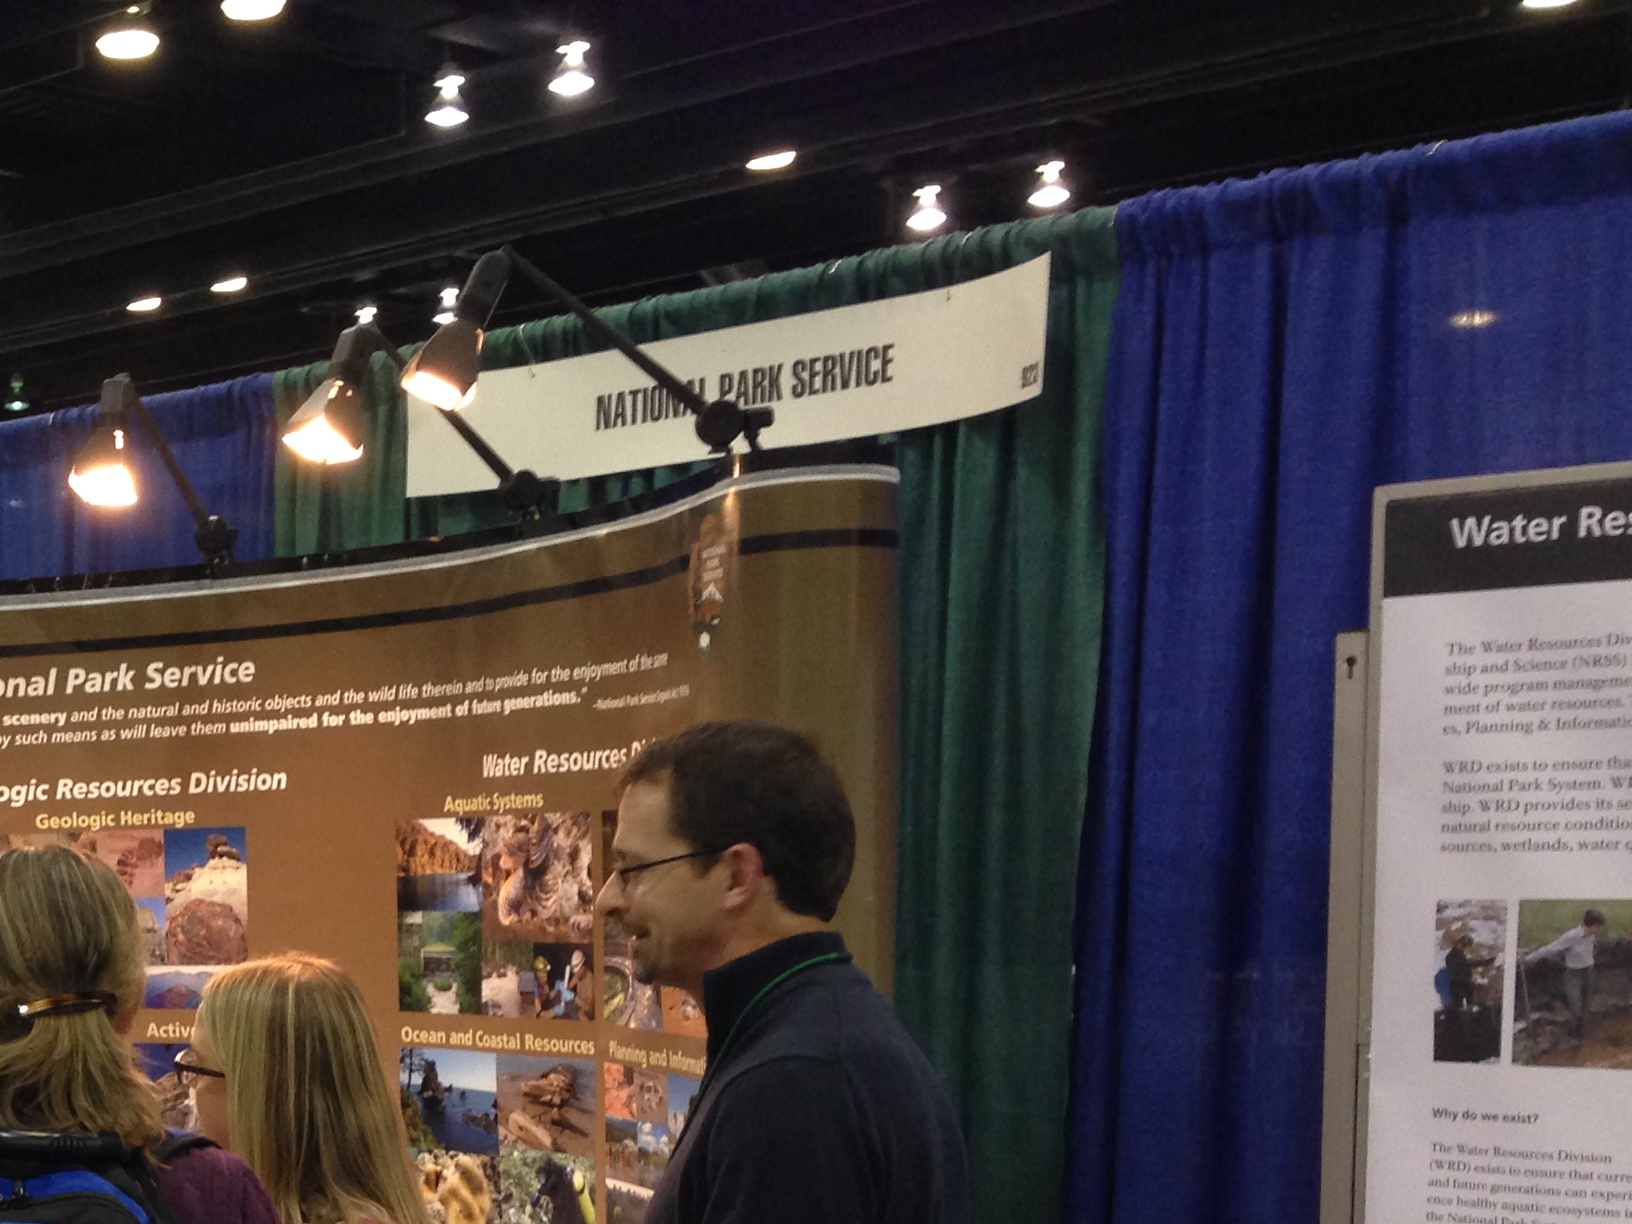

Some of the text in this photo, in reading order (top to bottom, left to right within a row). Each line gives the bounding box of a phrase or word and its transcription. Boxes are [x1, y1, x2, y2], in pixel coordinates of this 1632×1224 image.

[719, 361, 784, 406] PARK
[790, 343, 895, 399] SERVICE
[1449, 514, 1567, 549] Water
[1446, 636, 1603, 657] The Water Resources
[66, 662, 135, 694] Park
[144, 656, 256, 690] Service
[1445, 660, 1476, 677] ship
[1481, 660, 1509, 674] and
[1513, 658, 1568, 673] Science
[2, 708, 67, 728] scenery
[70, 706, 97, 723] and
[101, 705, 124, 720] the
[128, 701, 179, 718] natural
[182, 700, 209, 716] and
[212, 697, 262, 714] historic
[265, 694, 312, 713] objects
[315, 689, 340, 706] and
[343, 688, 365, 704] the
[368, 684, 396, 702] wild
[399, 684, 418, 700] life
[422, 681, 462, 698] therein
[465, 676, 484, 693] and
[485, 677, 494, 692] to
[495, 671, 528, 693] provide
[531, 667, 548, 685] for
[551, 664, 570, 682] the
[573, 658, 627, 682] enjoyment
[629, 653, 640, 672] of
[1444, 679, 1548, 697] wide program
[1443, 700, 1546, 715] ment of water
[15, 729, 48, 746] such
[51, 730, 98, 744] means
[101, 728, 116, 742] as
[120, 724, 146, 741] will
[150, 722, 187, 739] leave
[190, 720, 226, 736] them
[230, 712, 318, 735] unimpaired
[322, 711, 345, 727] for
[349, 708, 374, 725] the
[378, 703, 452, 725] enjoyment
[456, 700, 469, 717] of
[472, 698, 501, 715] future
[482, 748, 627, 778] Water Resources
[1443, 758, 1603, 774] WRD exists to ensure
[56, 774, 181, 800] Resources
[188, 768, 287, 795] Division
[1443, 779, 1504, 794] National
[1508, 778, 1542, 792] Park
[444, 792, 544, 816] Aquatic Systems
[36, 808, 195, 831] Geologic Heritage
[401, 1025, 595, 1055] Ocean and Coastal Resources
[609, 1039, 646, 1068] Planning
[648, 1047, 667, 1067] and
[1432, 1107, 1539, 1125] Why do we exist?
[1431, 1142, 1612, 1165] The Water Resources Division
[1429, 1159, 1593, 1181] (WRD) exists to ensure that
[1427, 1177, 1586, 1199] and future generations can
[1426, 1211, 1444, 1224] the
[1456, 1196, 1620, 1219] healthy aquatic ecosystems
